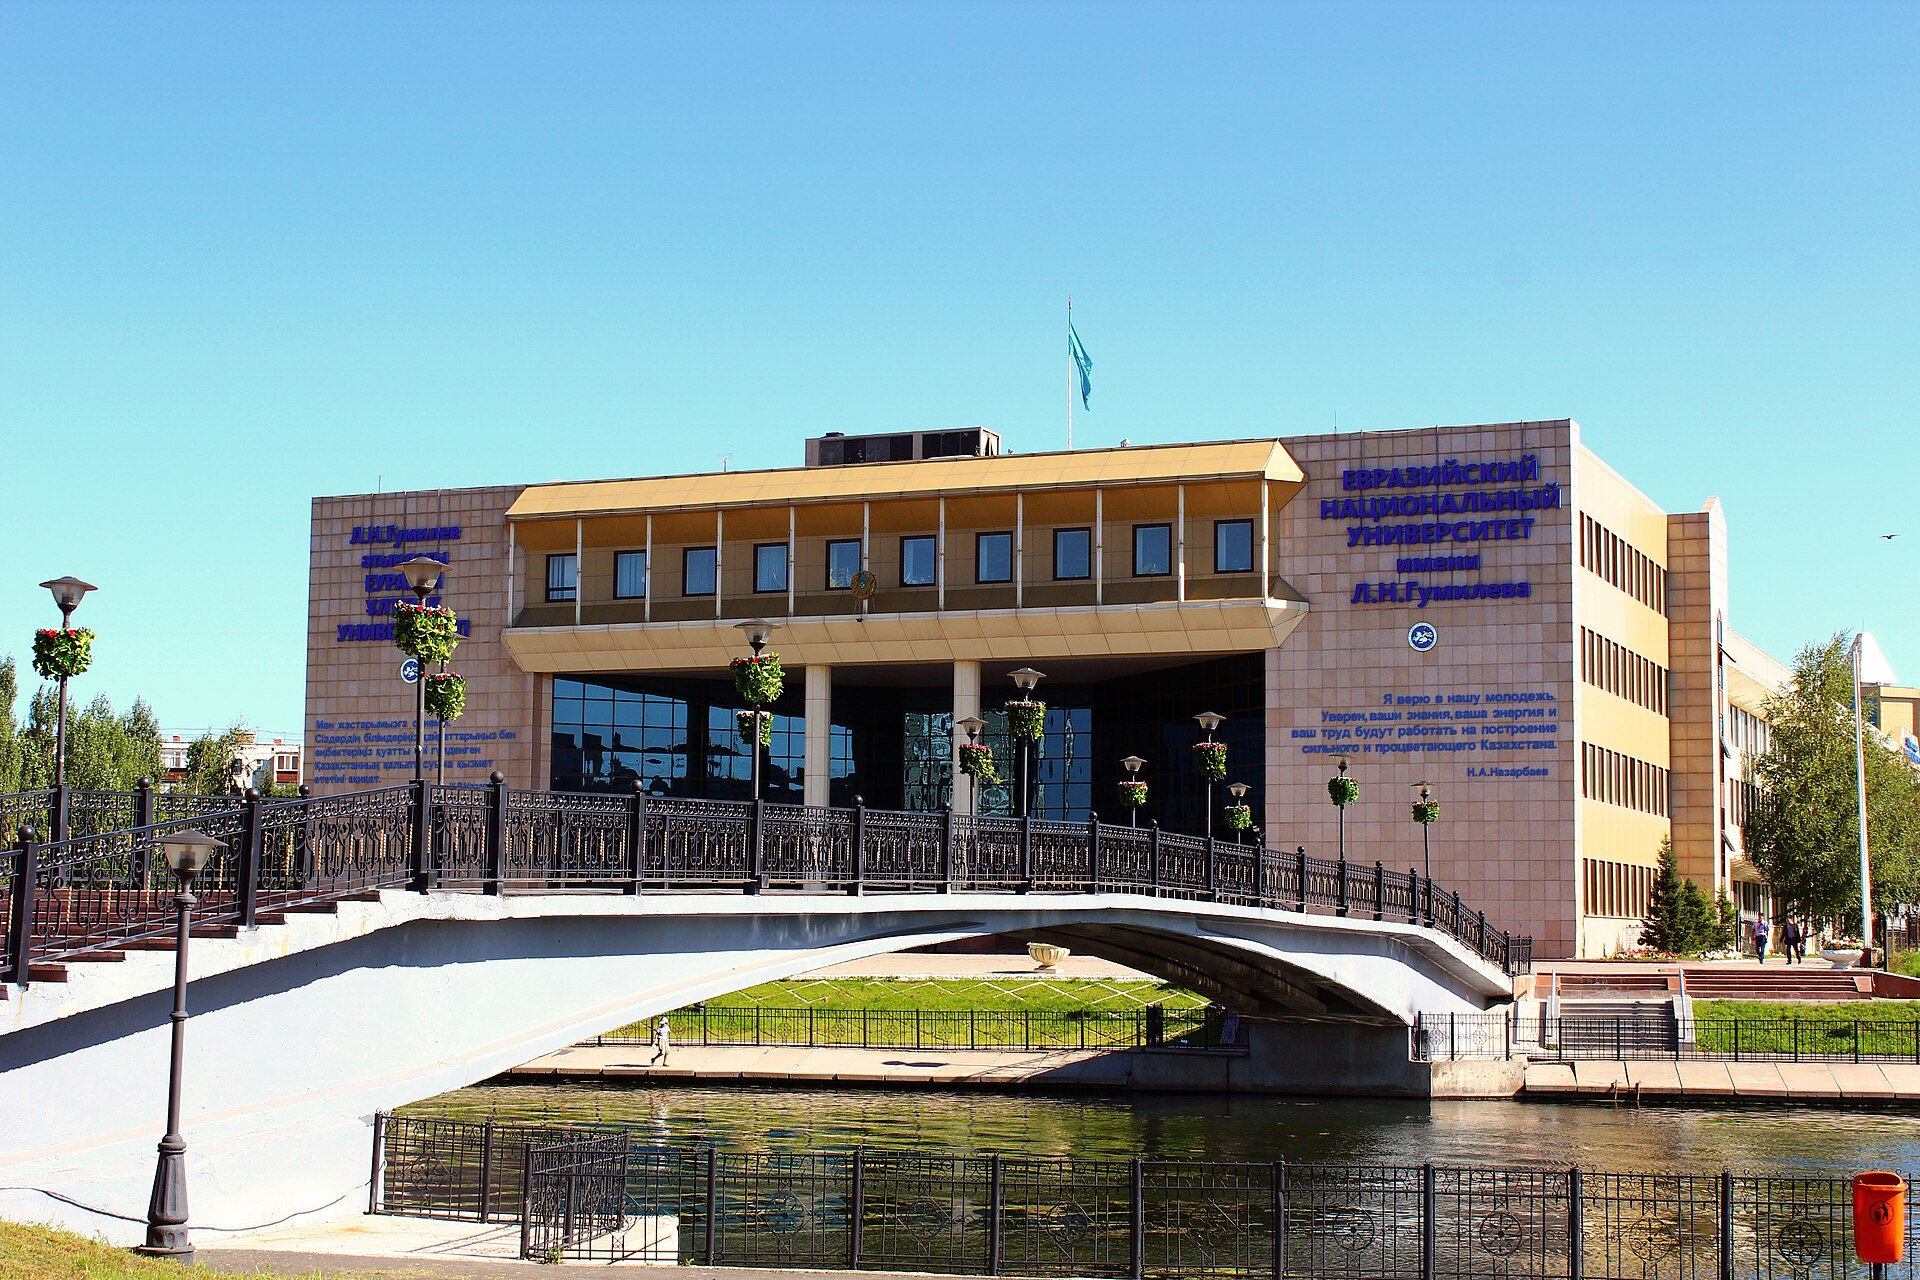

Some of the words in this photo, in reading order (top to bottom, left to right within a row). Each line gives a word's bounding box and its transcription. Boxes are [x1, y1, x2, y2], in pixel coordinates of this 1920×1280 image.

[1342, 454, 1538, 491] ЕВРАЗИЙСКИЙ
[1320, 482, 1562, 522] НАЦИОНАЛЬНЫЙ
[349, 525, 460, 547] Л.Н.Гумилев
[1346, 518, 1535, 547] УНИВЕРСИТЕТ
[1396, 554, 1481, 572] имени
[1351, 581, 1531, 607] Л.Н.Гумилева
[1383, 693, 1393, 704] Я
[1397, 695, 1431, 706] верю
[1434, 694, 1444, 704] в
[1446, 693, 1481, 705] нашу
[1485, 691, 1557, 703] молодежь.
[1321, 711, 1368, 723] Уверен,
[1369, 711, 1403, 721] ваши
[1454, 709, 1489, 719] ваша
[1492, 708, 1546, 720] энергия
[1548, 708, 1557, 717] и
[1291, 729, 1318, 739] ваш
[1321, 728, 1352, 740] труд
[1354, 725, 1393, 739] будут
[1397, 724, 1458, 738] работать
[1460, 725, 1478, 735] на
[1481, 723, 1558, 737] построение
[1302, 743, 1359, 753] сильного
[1363, 744, 1372, 753] и
[1375, 741, 1477, 754] процветающего
[1480, 739, 1557, 751] Казахстана.
[1466, 767, 1549, 777] Н.А.Назарбаев
